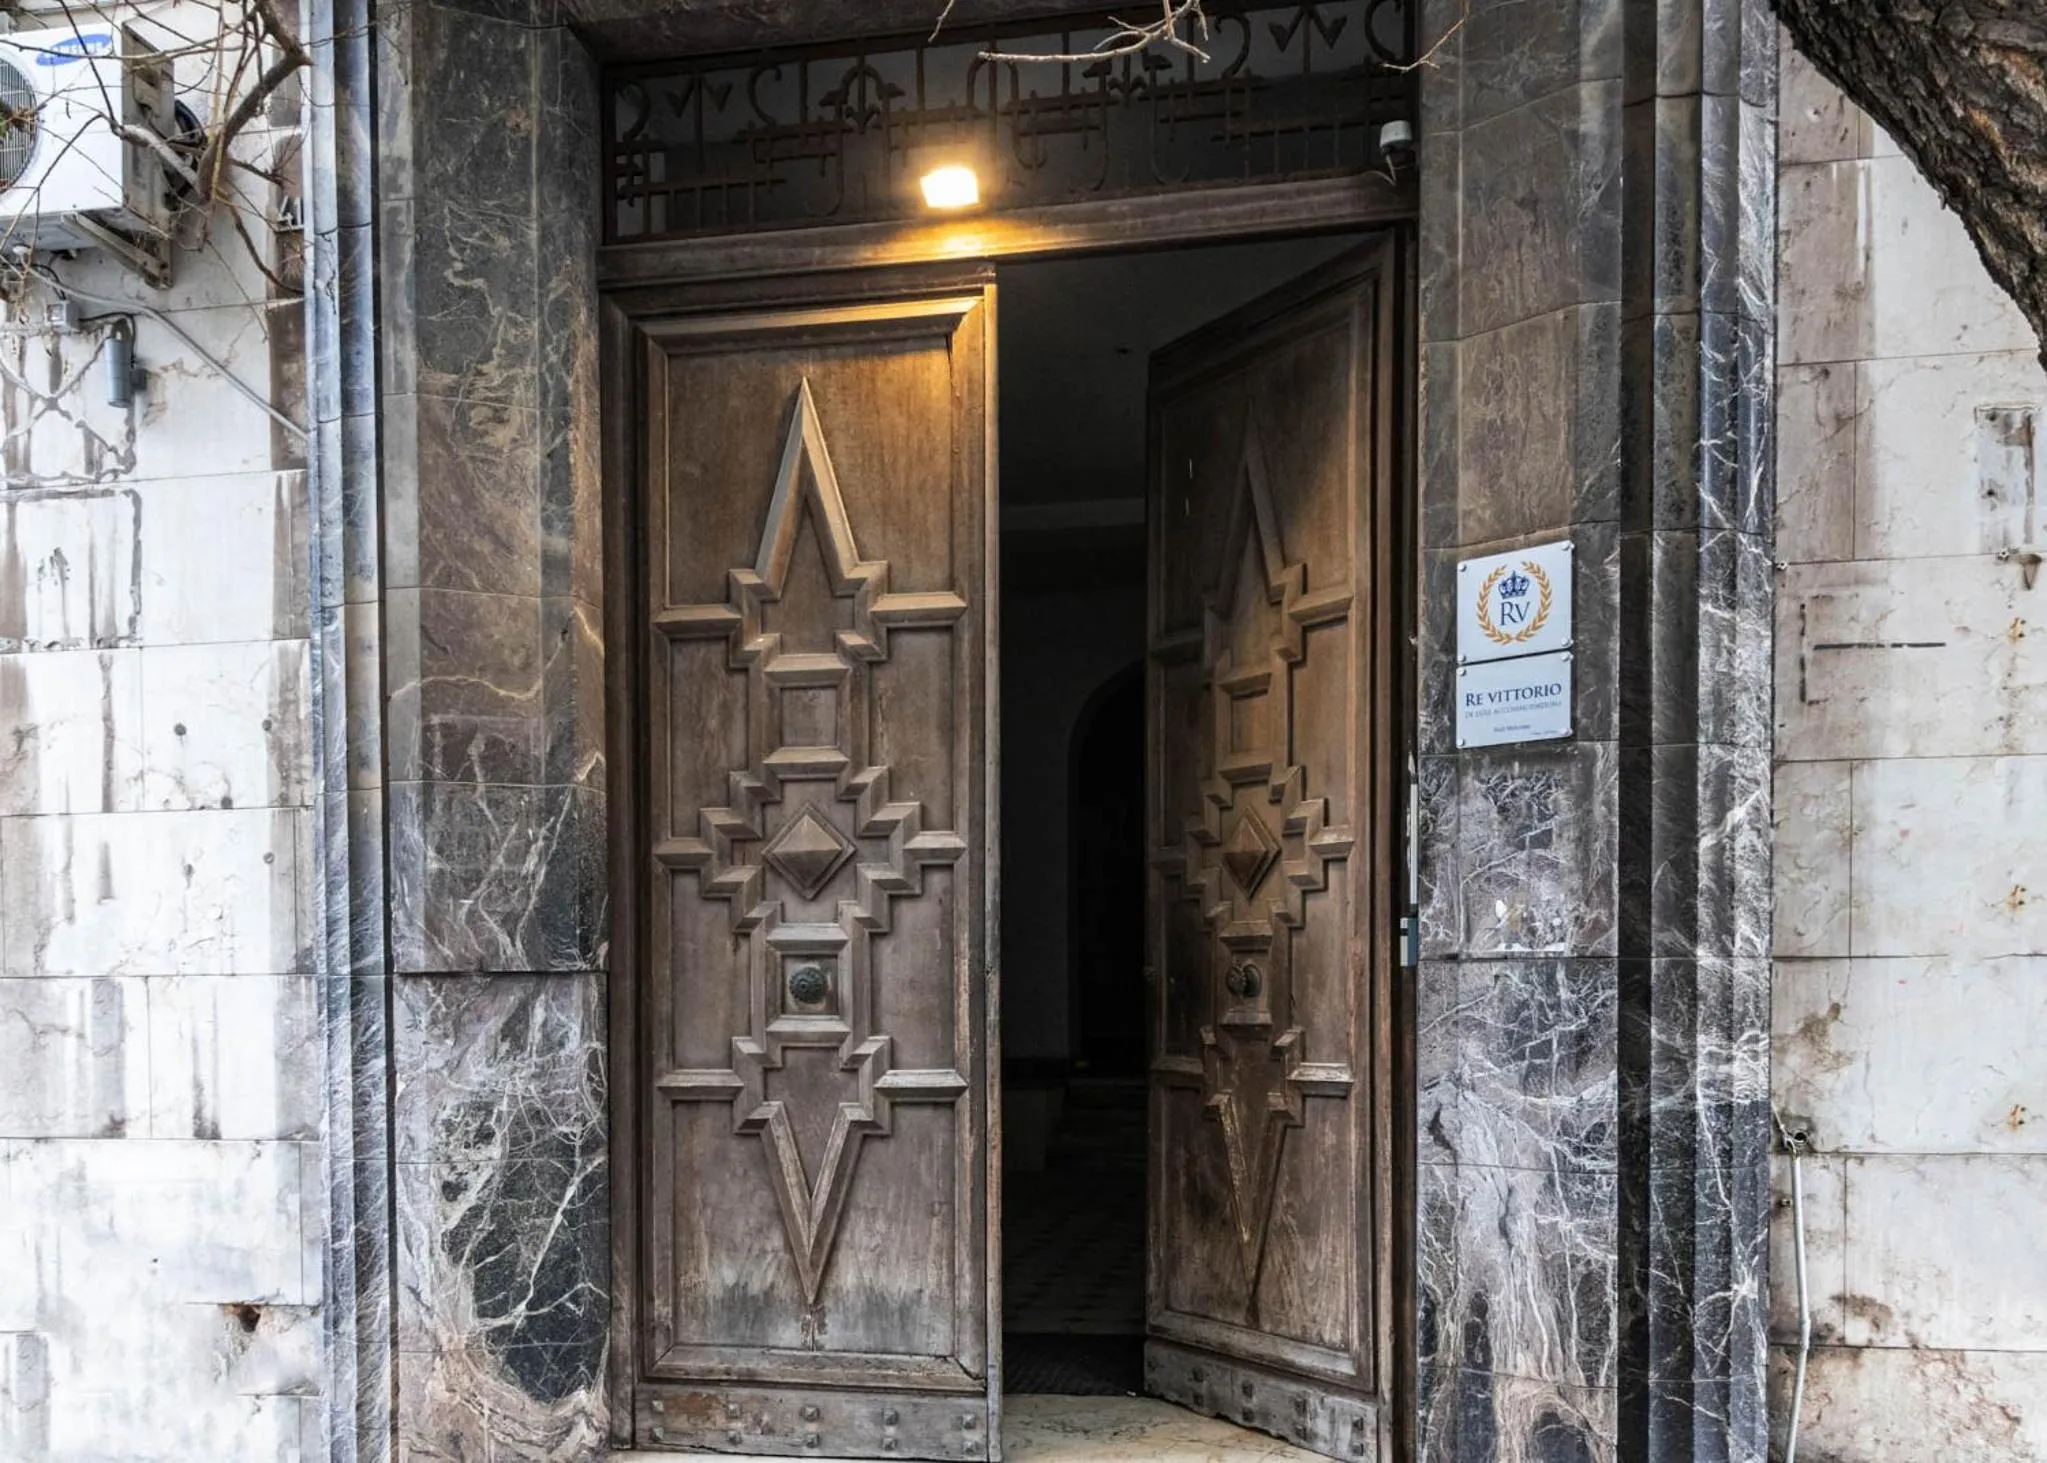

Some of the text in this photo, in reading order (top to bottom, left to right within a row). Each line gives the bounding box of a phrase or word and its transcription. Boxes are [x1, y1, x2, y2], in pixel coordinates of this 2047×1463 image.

[1500, 601, 1530, 626] RV
[1465, 683, 1562, 706] RE VITTORIO
